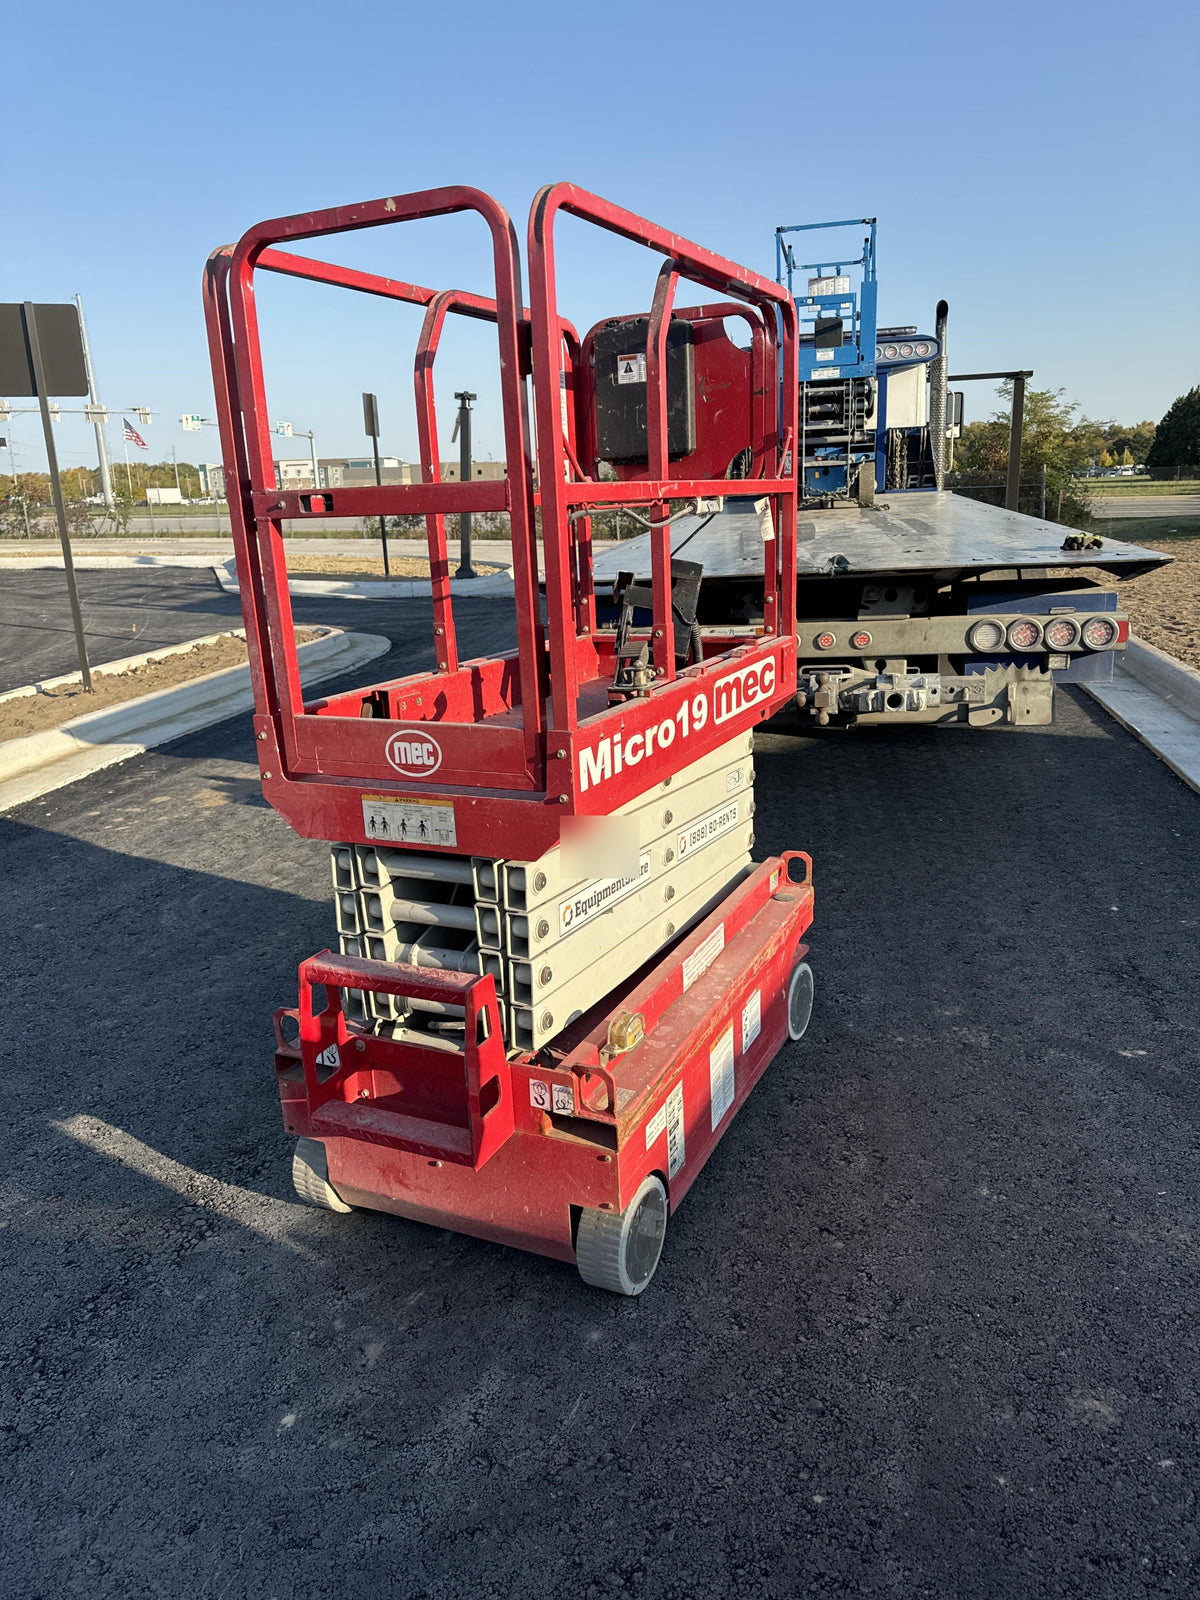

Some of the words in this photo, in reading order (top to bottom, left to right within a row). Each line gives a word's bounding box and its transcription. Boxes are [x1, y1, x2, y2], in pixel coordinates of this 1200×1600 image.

[715, 662, 775, 720] mec
[393, 741, 435, 766] mec
[689, 823, 708, 847] (888)
[709, 807, 737, 834] 80-RENTS
[574, 861, 650, 918] Equipmentre
